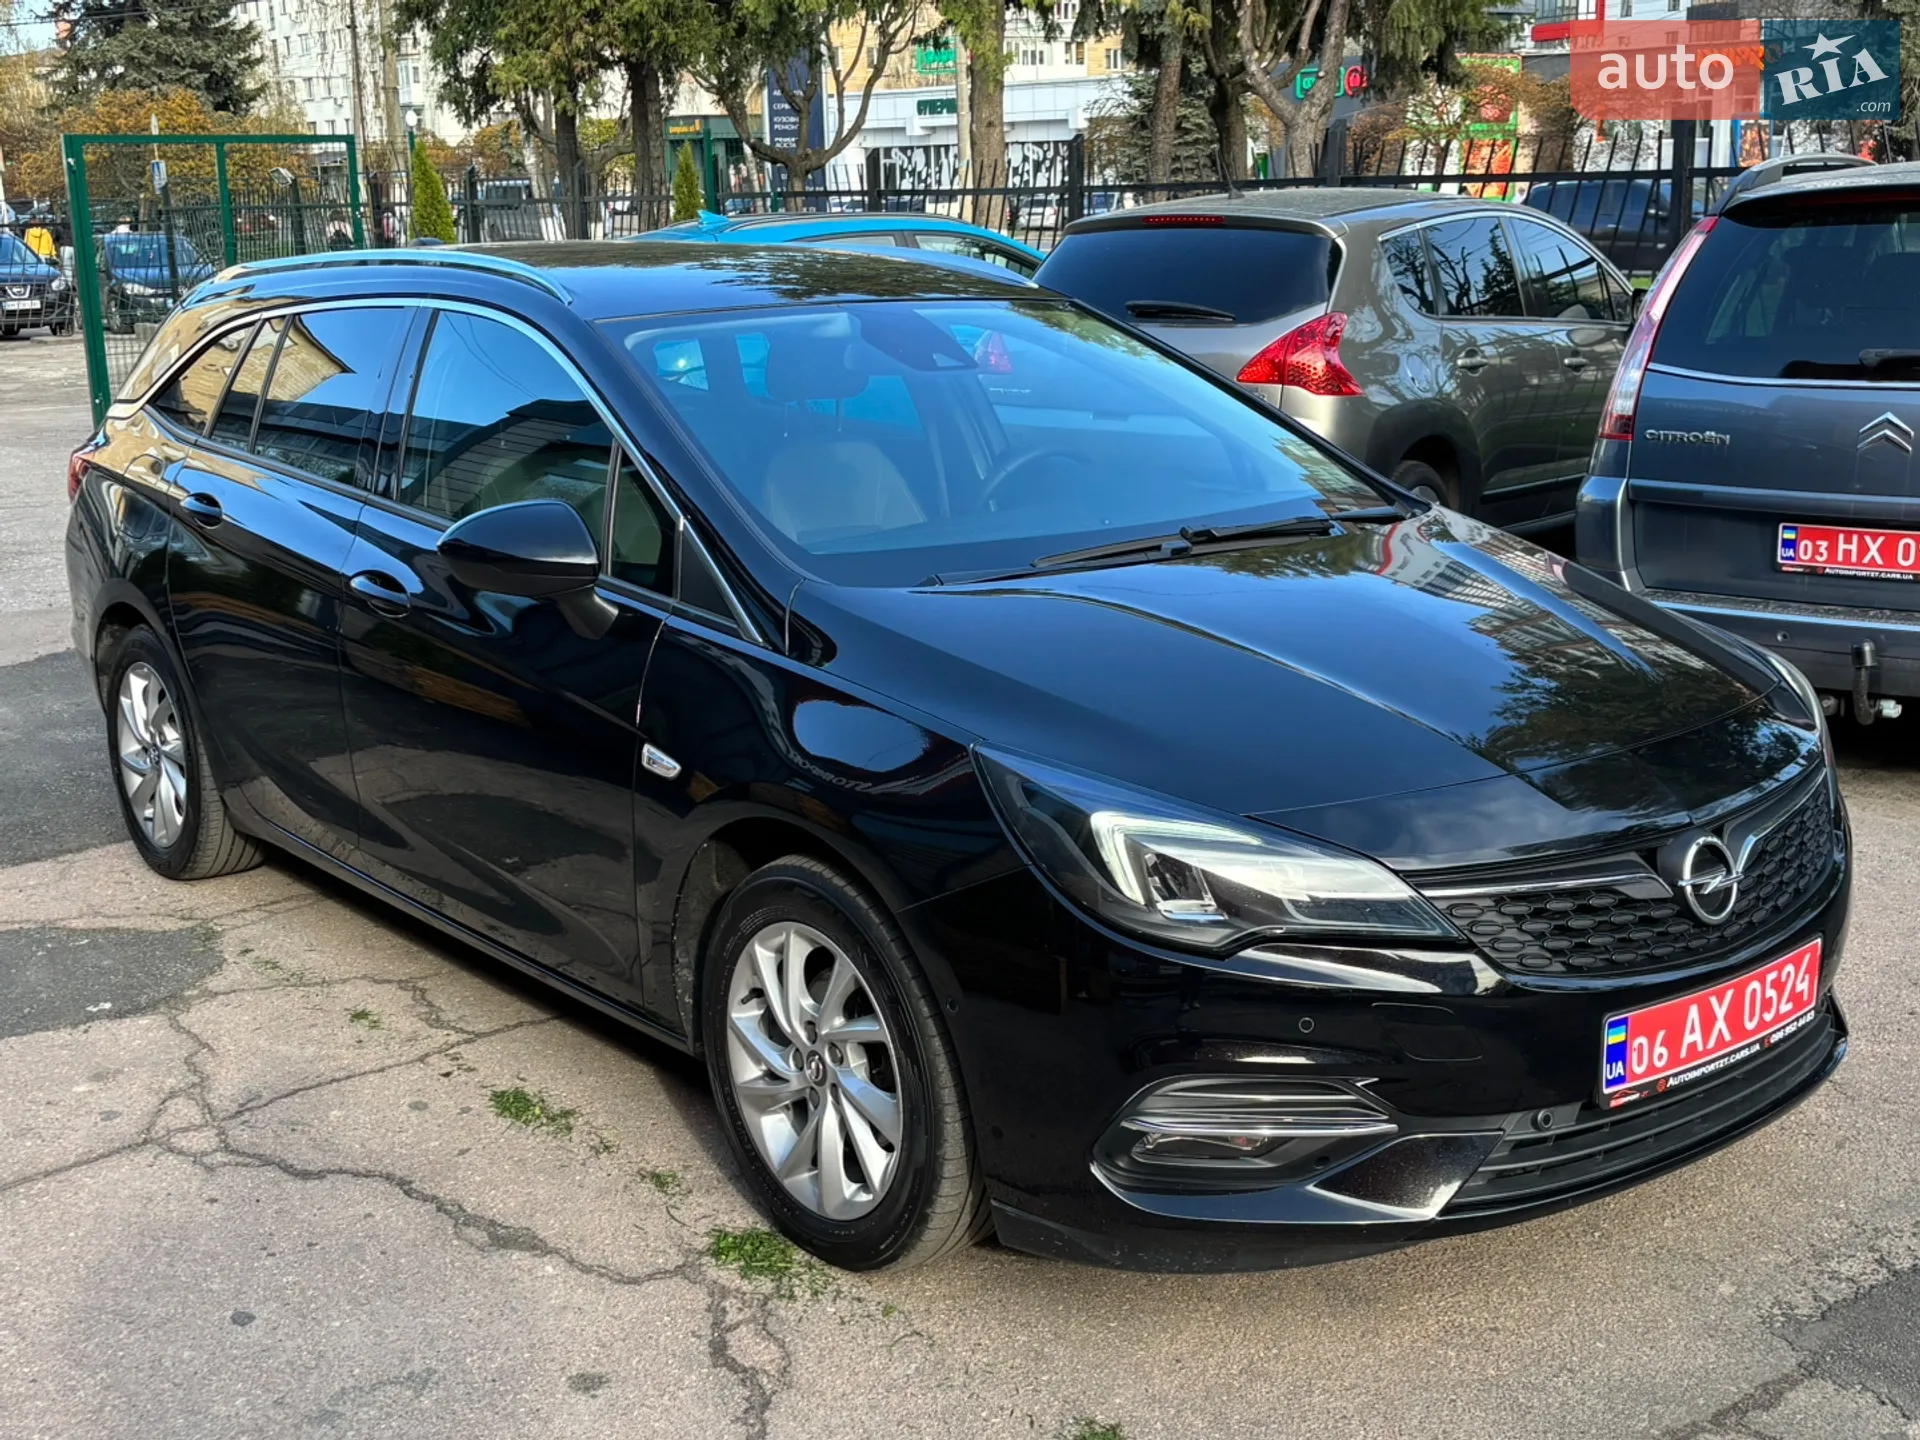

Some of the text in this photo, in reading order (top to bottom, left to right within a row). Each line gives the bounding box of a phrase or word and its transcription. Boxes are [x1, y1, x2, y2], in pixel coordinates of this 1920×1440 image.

[1781, 533, 1920, 567] UA 03 HX 0
[1606, 952, 1812, 1080] UA 06 AX 0524
